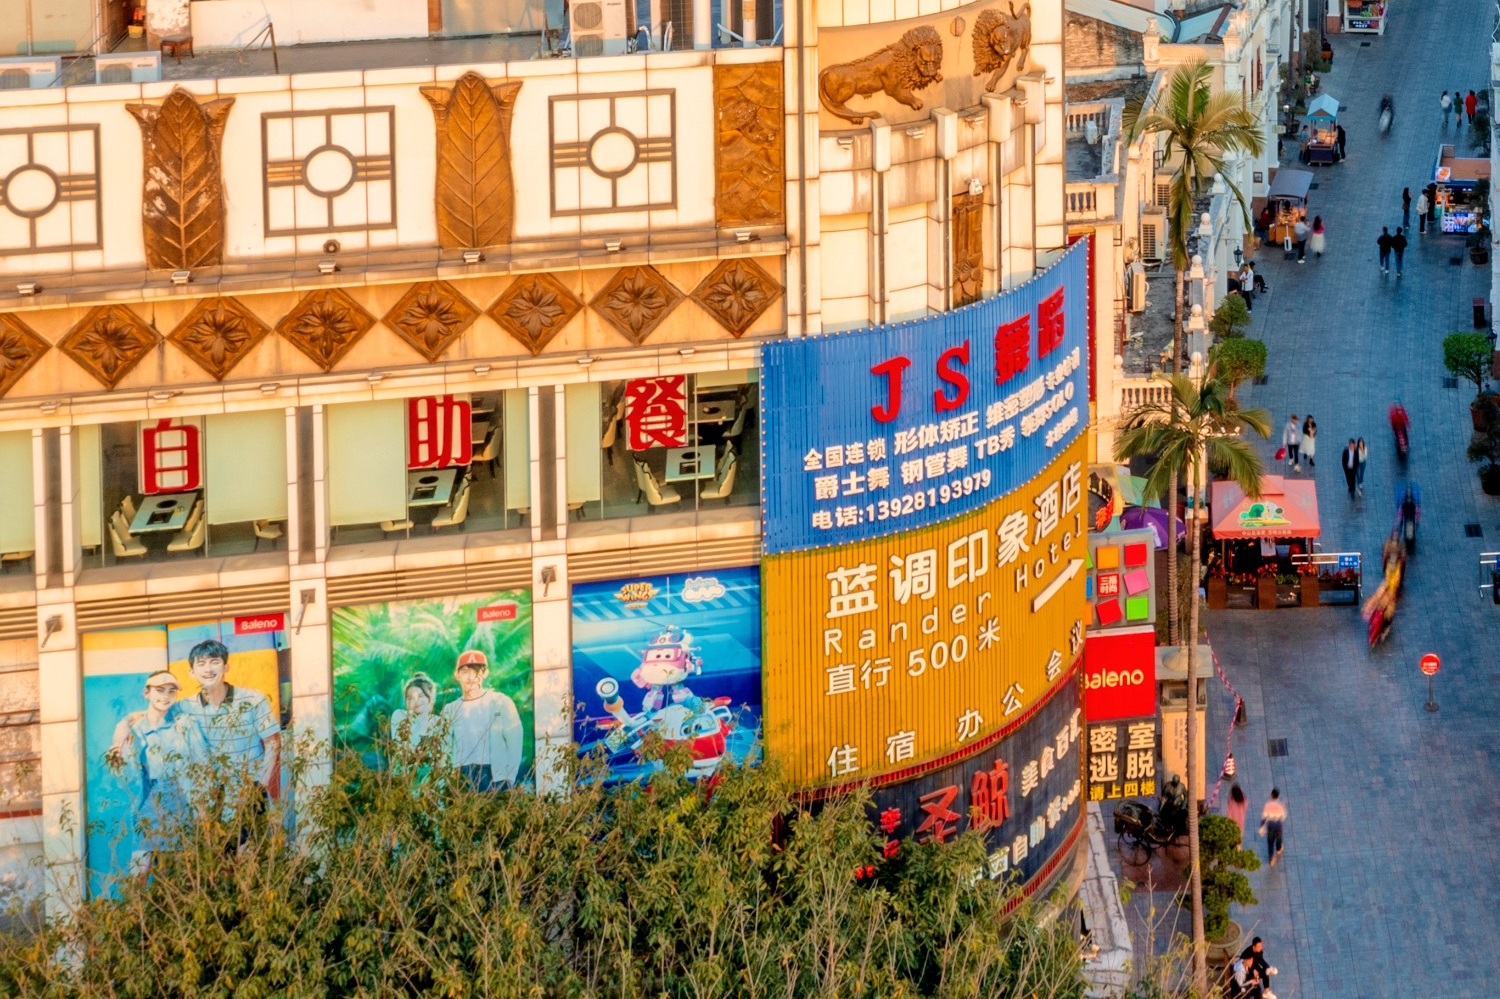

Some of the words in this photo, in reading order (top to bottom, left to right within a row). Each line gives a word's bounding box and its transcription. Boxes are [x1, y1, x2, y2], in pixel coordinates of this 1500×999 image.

[803, 437, 887, 472] 全国连锁
[894, 410, 980, 456] 形体矫正
[814, 465, 891, 501] 爵士舞
[900, 444, 969, 485] 钢管舞
[974, 424, 1016, 460] TB秀
[825, 460, 1082, 619] 蓝调印象酒店
[482, 608, 512, 620] Baleno
[824, 590, 992, 657] Rander
[1014, 512, 1082, 593] Hotel
[240, 618, 279, 631] Baleno
[827, 730, 916, 777] 住宿
[957, 682, 1025, 742] 办公
[1089, 722, 1156, 753] 密室
[1089, 750, 1156, 783] 逃脱
